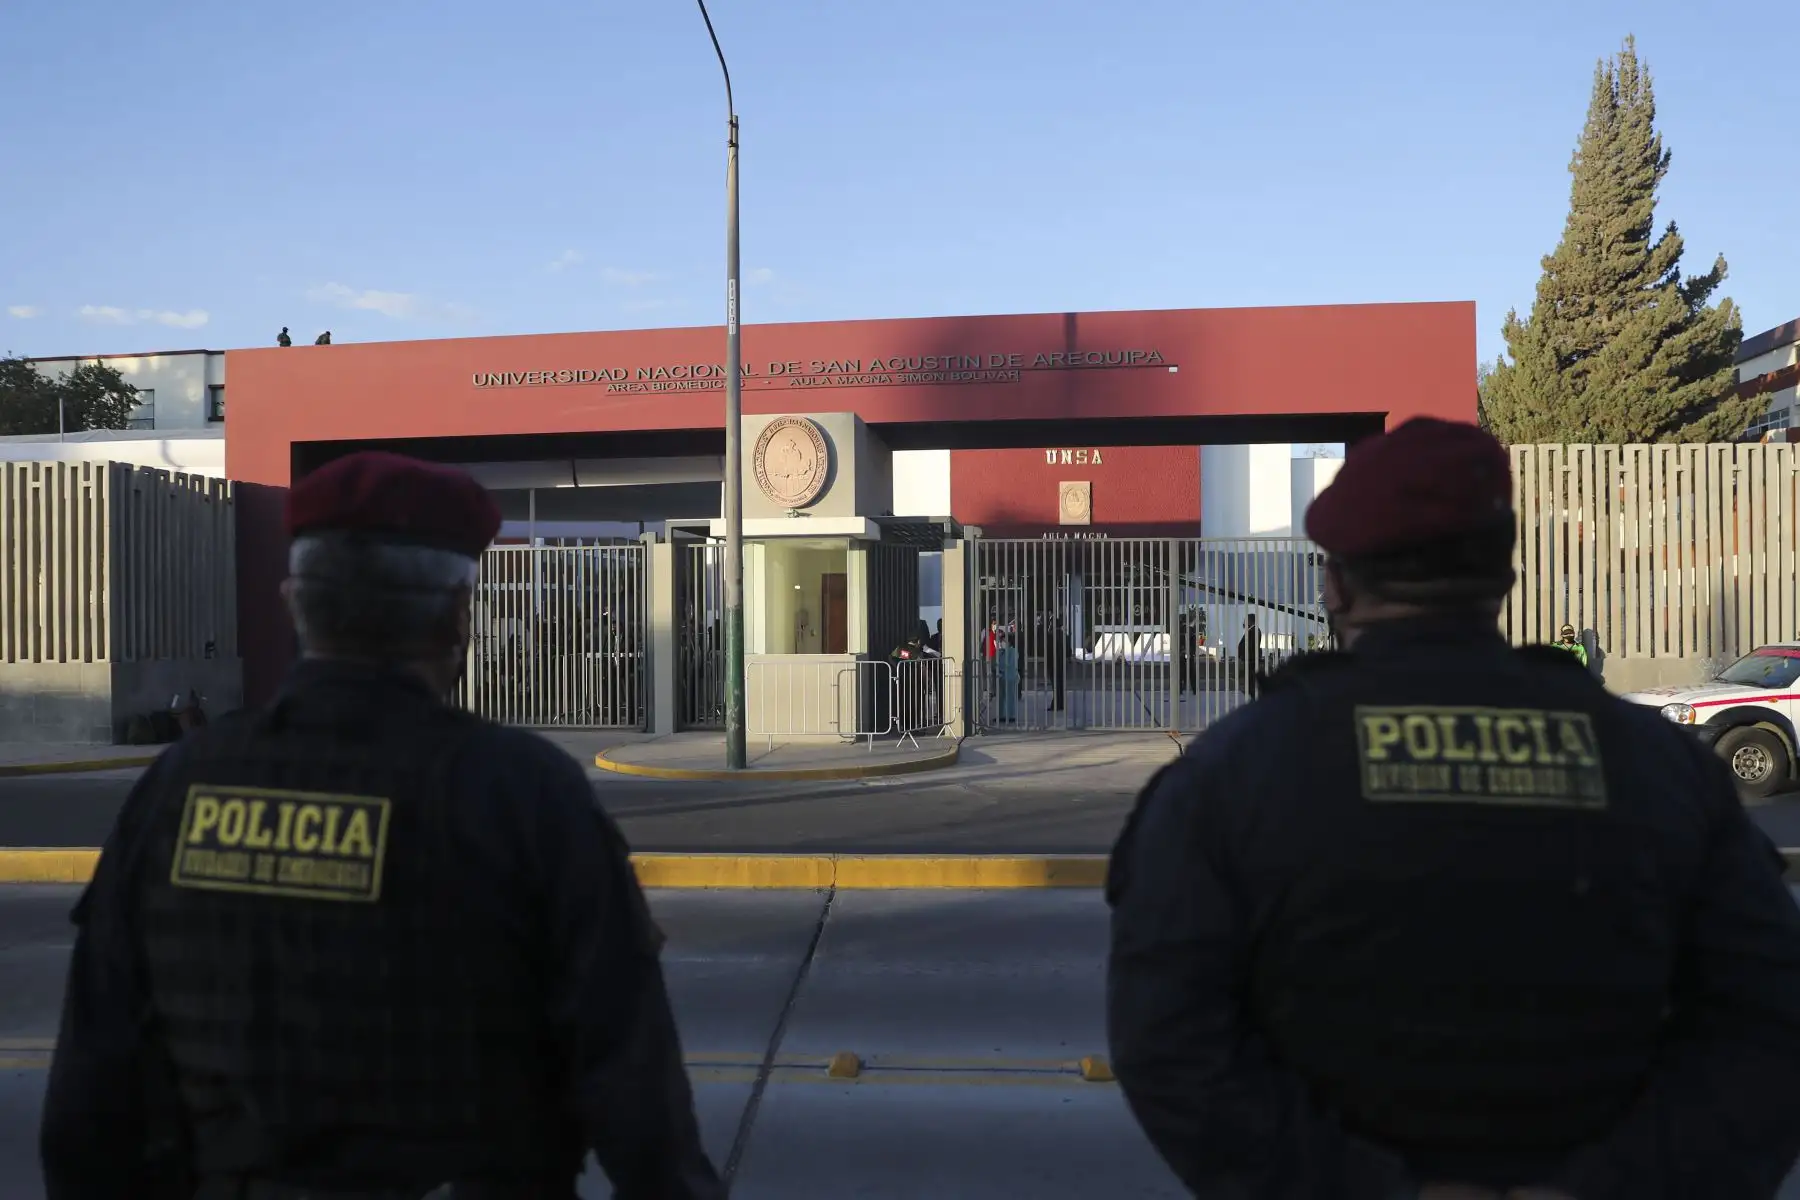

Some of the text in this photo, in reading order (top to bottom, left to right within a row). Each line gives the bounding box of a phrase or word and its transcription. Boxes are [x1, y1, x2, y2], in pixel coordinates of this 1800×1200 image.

[472, 350, 1165, 387] UNIVERSIDAD NACIONL DE SAN AGUSTIN DE AREQUIPA
[607, 383, 649, 393] AREA
[790, 376, 833, 387] AULA
[837, 374, 893, 385] MAGNA
[897, 372, 945, 384] SIMON
[951, 369, 1020, 381] BOLIVAR
[1046, 449, 1103, 465] UNSA
[1042, 532, 1108, 540] AULA MAGNA
[1362, 714, 1598, 767] POLICIA
[187, 796, 374, 856] POLICIA
